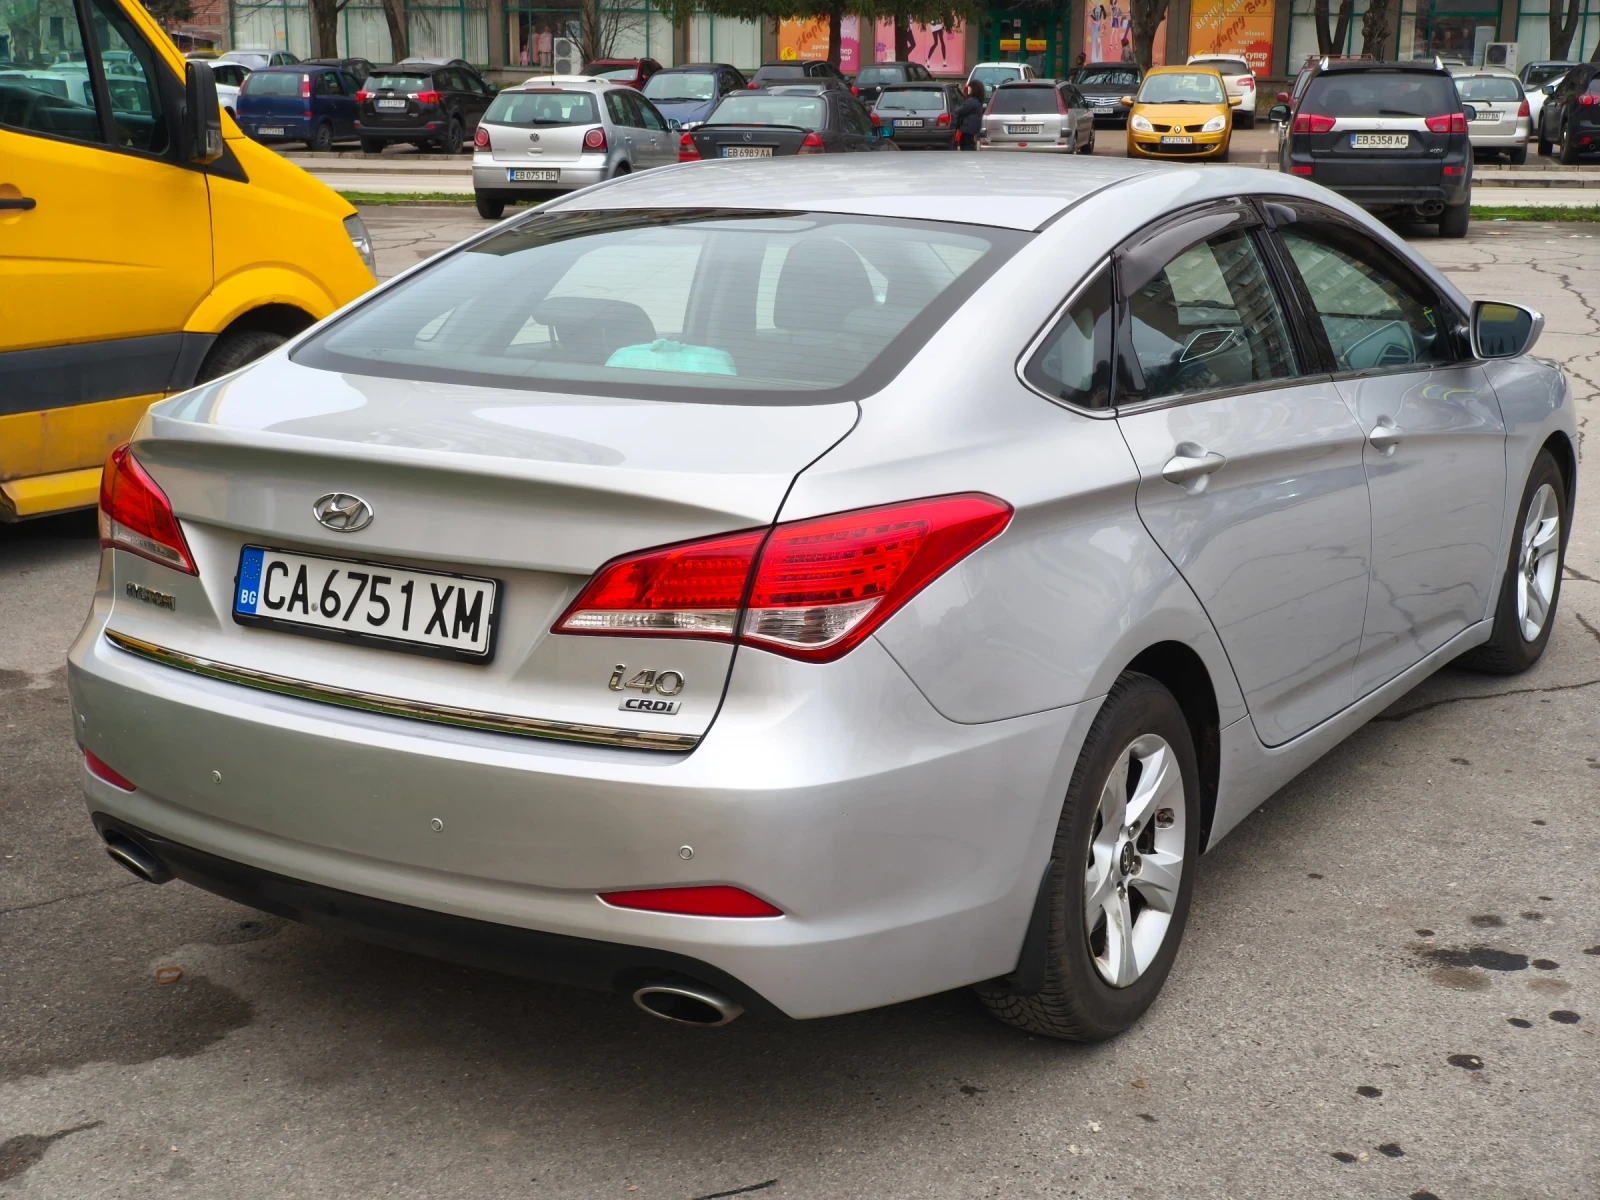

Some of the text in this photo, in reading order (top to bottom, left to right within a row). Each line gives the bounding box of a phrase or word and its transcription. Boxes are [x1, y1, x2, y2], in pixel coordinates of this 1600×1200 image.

[1211, 0, 1245, 30] МАГАЗИ
[1210, 16, 1246, 53] Happy
[1246, 52, 1268, 61] супер
[1357, 136, 1407, 145] EB 5358 AC
[728, 149, 738, 157] EB
[516, 171, 557, 180] EB 0751 BH
[241, 588, 257, 605] BG
[263, 560, 485, 643] CA 6751 XM
[608, 663, 686, 697] i40
[625, 698, 675, 712] CRDi
